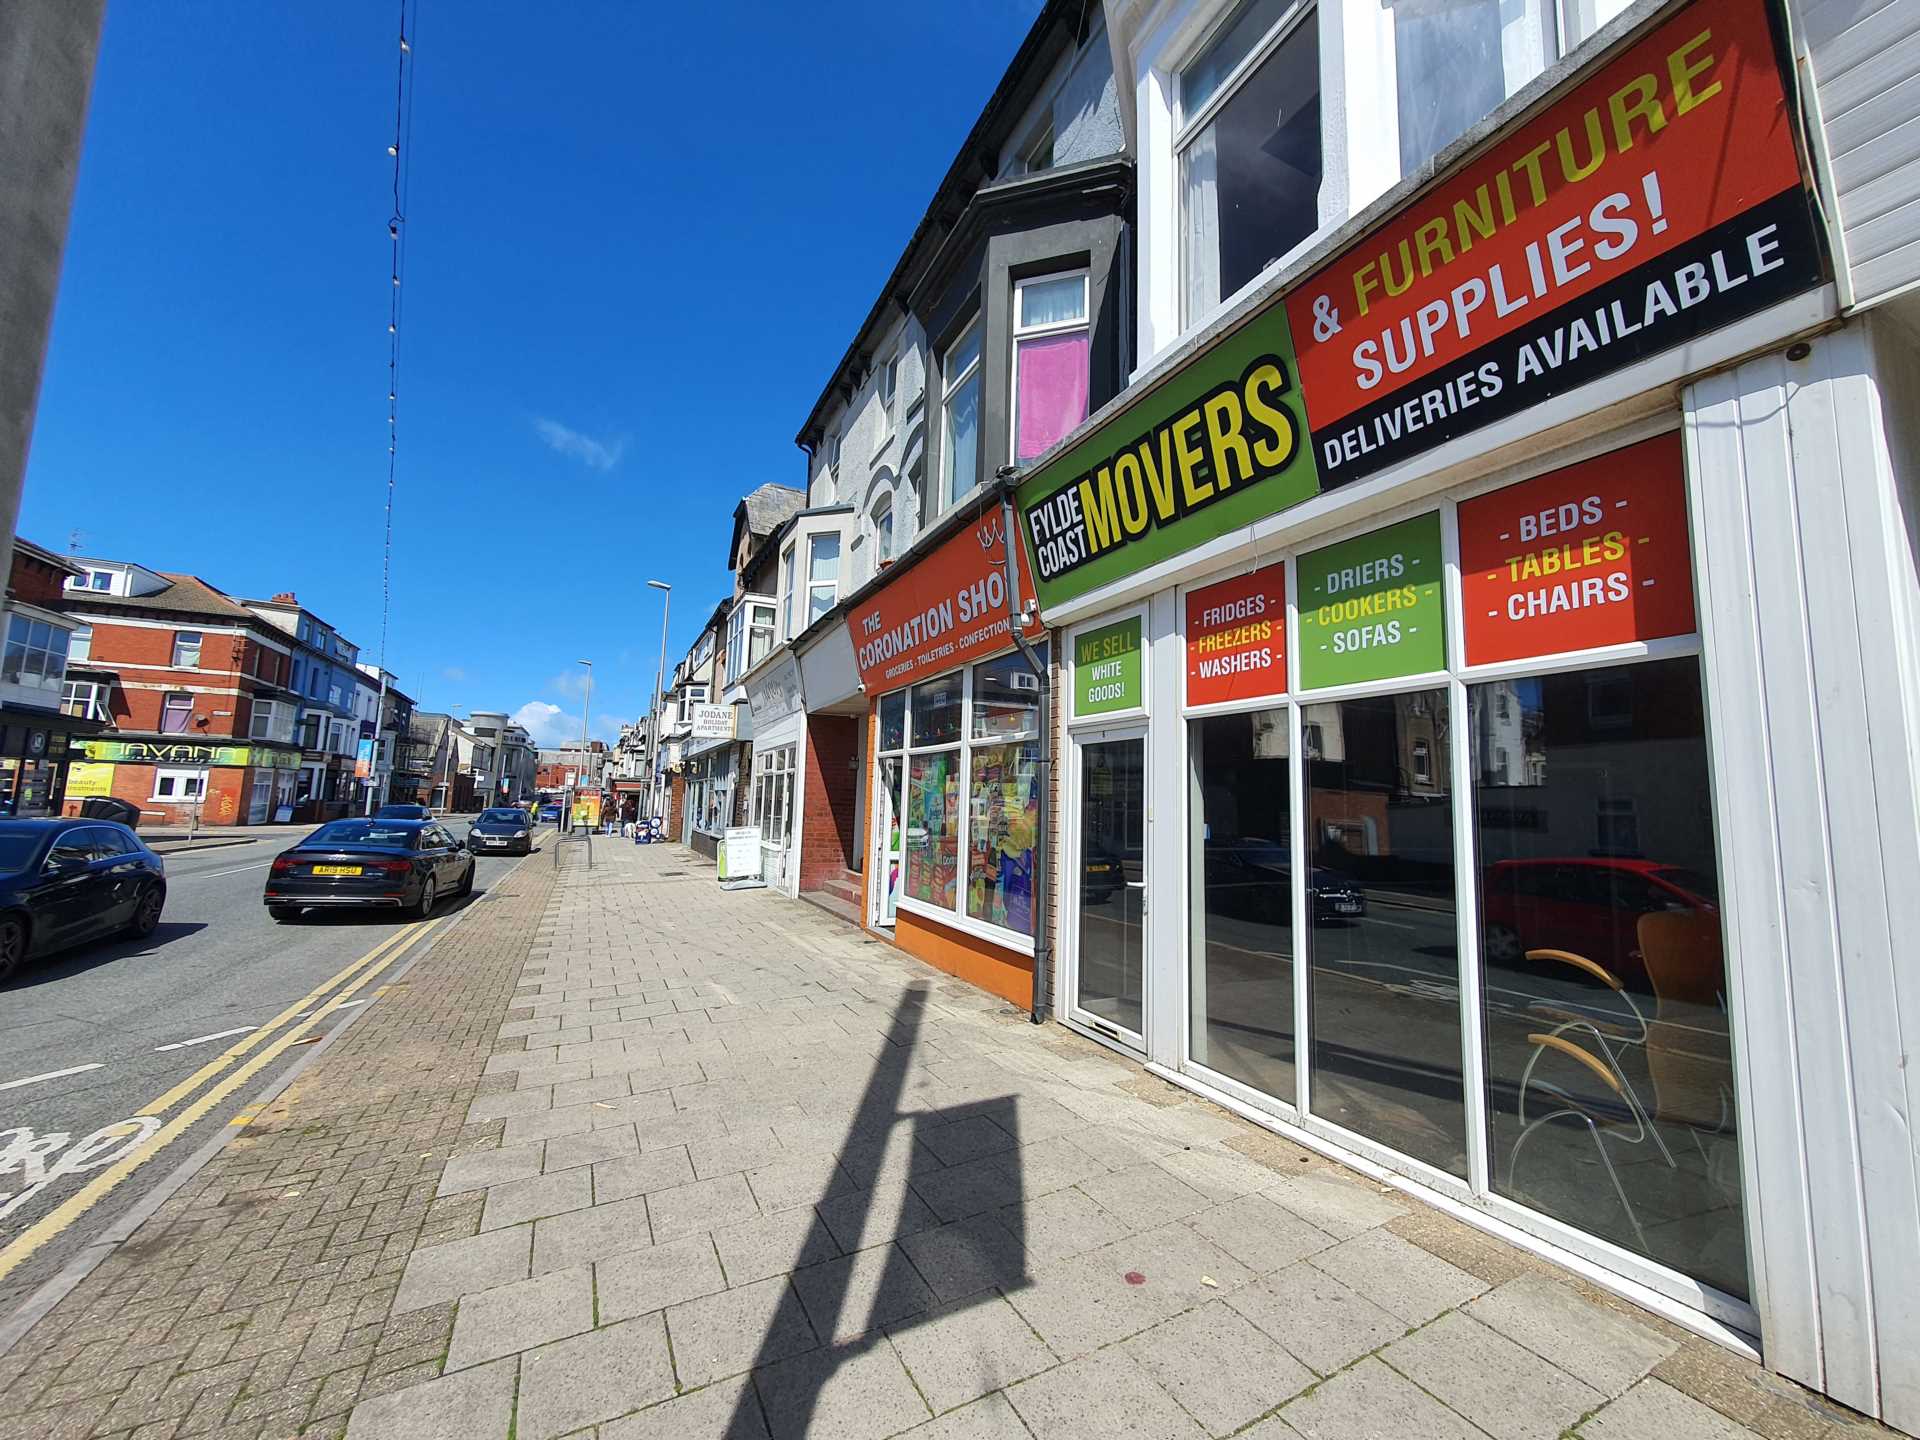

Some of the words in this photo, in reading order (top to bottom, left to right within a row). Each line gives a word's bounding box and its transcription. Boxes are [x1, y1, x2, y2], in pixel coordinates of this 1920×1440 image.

[1312, 295, 1342, 342] &
[1352, 28, 1722, 317] FURNITURE
[1352, 171, 1669, 391] SUPPLIES!
[1324, 361, 1503, 470] DELIVERIES
[1517, 224, 1785, 384] AVAILABLE
[1079, 364, 1293, 554] MOVERS
[1029, 486, 1083, 545] FYLDE
[1519, 495, 1603, 542] BEDS
[1038, 524, 1087, 577] COAST
[1505, 531, 1625, 582] TABLES
[1327, 553, 1404, 594] DRIERS
[859, 599, 953, 671] CORONATION
[958, 566, 1017, 623] SHO
[1203, 594, 1265, 628] FRIDGES
[1318, 584, 1417, 626] COOKERS
[1507, 572, 1629, 621] CHAIRS
[862, 611, 881, 636] THE
[1199, 620, 1272, 654] FREEZERS
[1333, 620, 1401, 653] SOFAS
[885, 662, 913, 679] GROCERIES
[917, 643, 954, 664] TOILETRIES
[959, 617, 1013, 648] CONFECTION
[1081, 641, 1100, 663] WE
[1103, 631, 1135, 657] SELL
[1199, 647, 1272, 679] WASHERS
[1088, 681, 1125, 703] GOODS!
[1091, 660, 1122, 681] WHITE
[698, 710, 733, 720] JODANE
